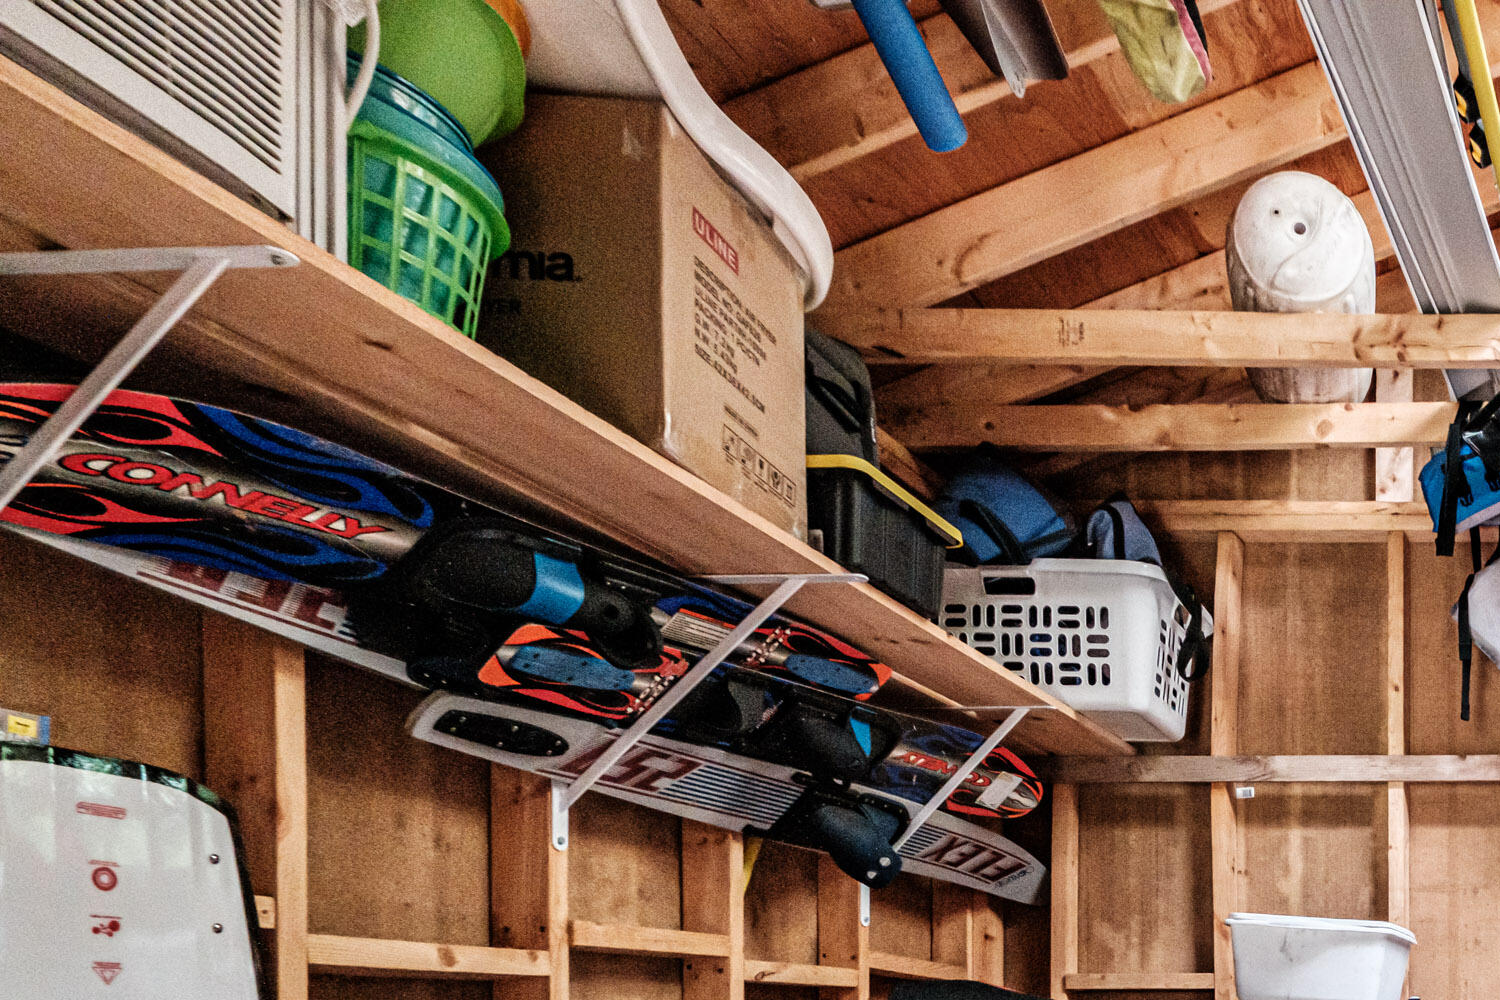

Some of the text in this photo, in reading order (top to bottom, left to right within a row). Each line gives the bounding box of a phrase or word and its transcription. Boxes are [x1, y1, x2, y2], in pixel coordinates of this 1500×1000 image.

[694, 212, 737, 269] ULINE
[58, 452, 394, 540] CONNELLY
[920, 837, 1026, 883] FLEX
